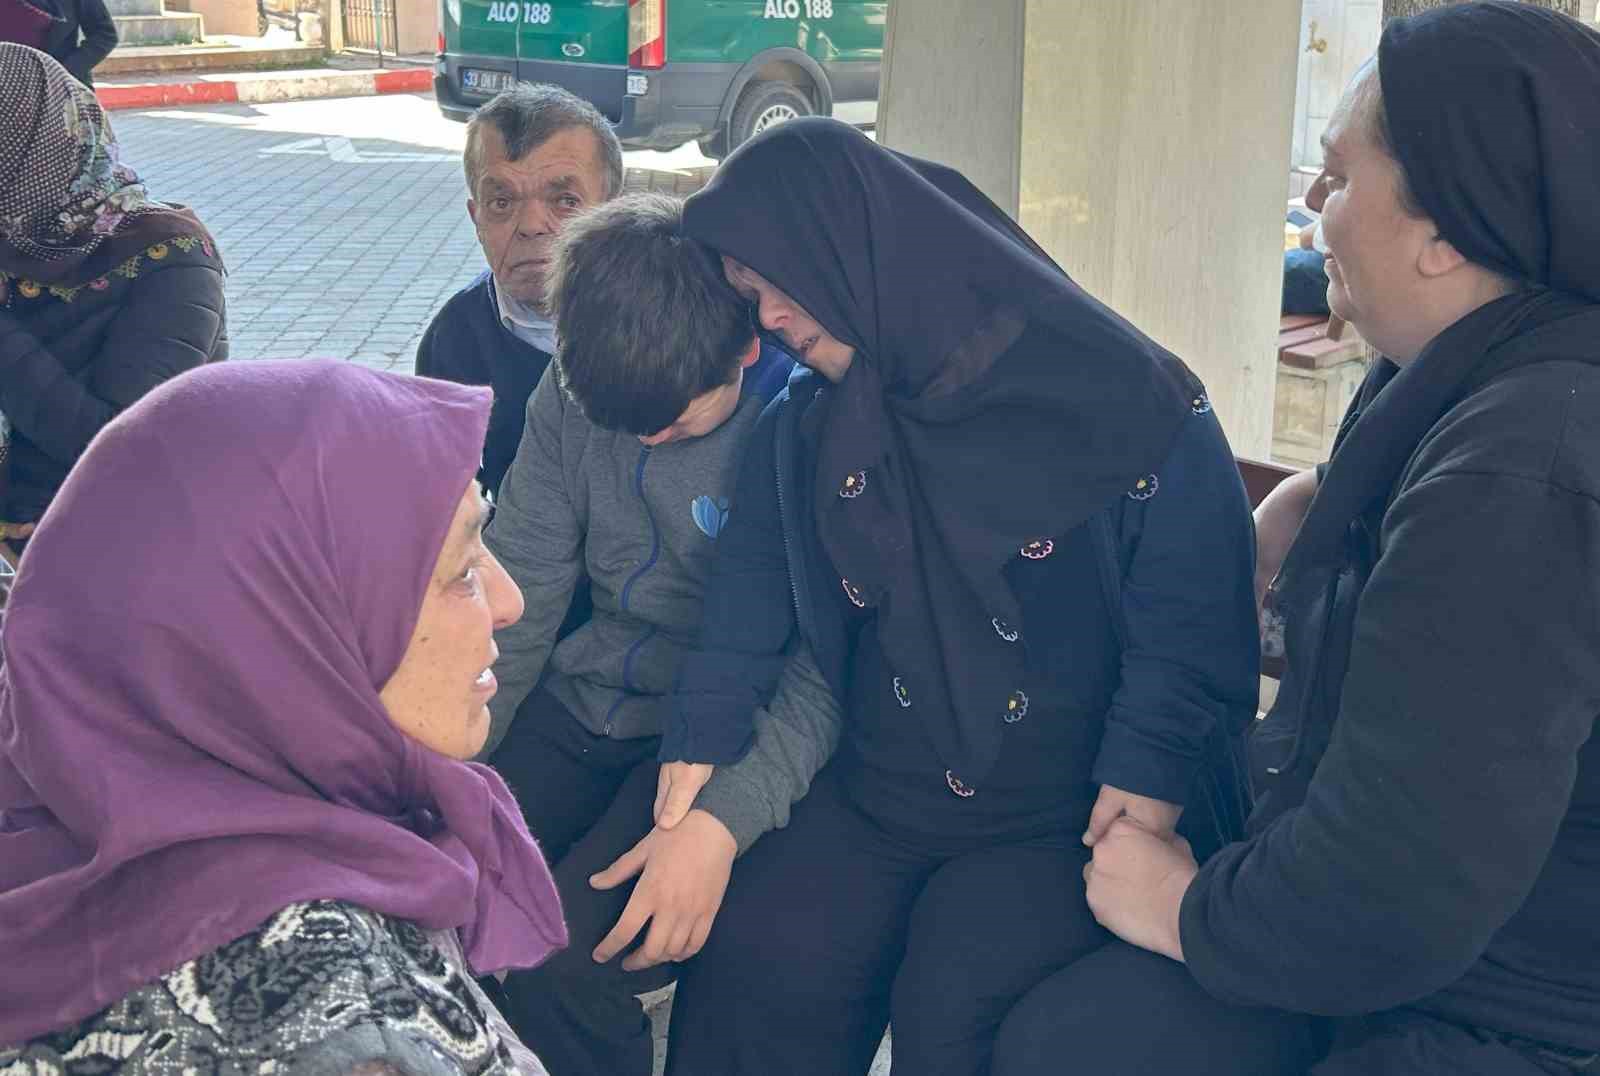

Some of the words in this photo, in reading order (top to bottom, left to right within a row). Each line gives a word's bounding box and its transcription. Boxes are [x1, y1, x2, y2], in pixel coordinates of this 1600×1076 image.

[487, 1, 519, 23] ALO
[523, 2, 552, 25] 188
[764, 0, 801, 19] ALO
[804, 0, 834, 19] 188
